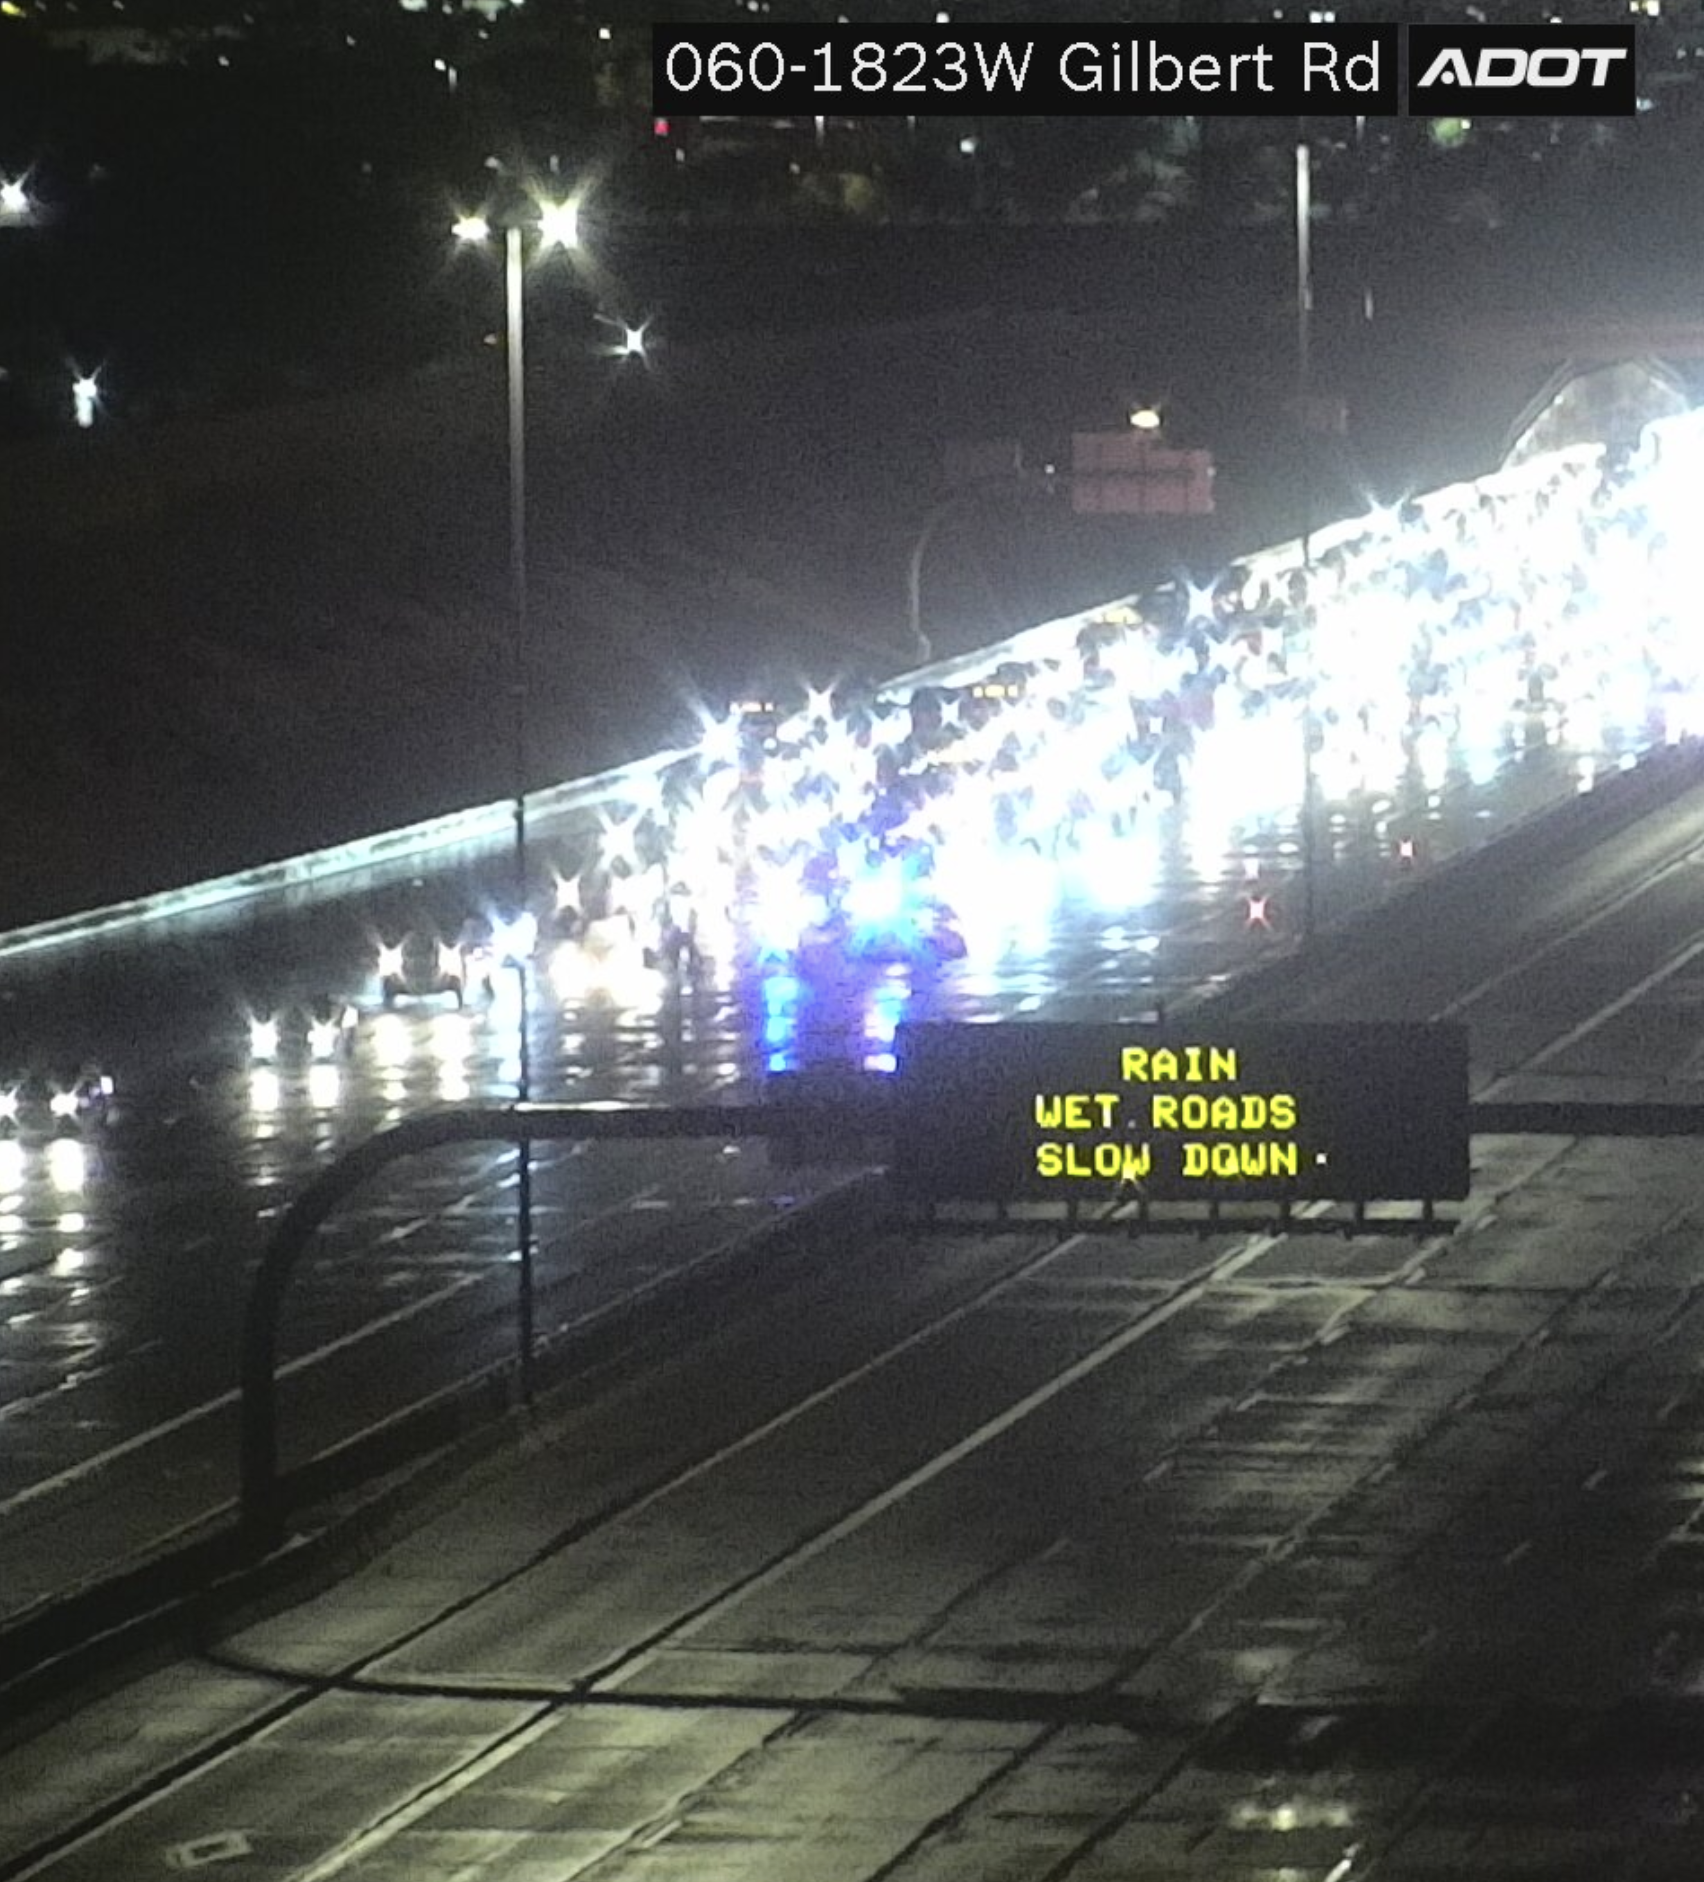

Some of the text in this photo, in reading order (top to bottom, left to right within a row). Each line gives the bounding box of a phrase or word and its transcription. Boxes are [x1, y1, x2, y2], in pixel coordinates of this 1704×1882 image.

[1121, 1046, 1237, 1082] RAIN
[1035, 1093, 1297, 1131] WET ROADS
[1036, 1141, 1297, 1178] SLOW DOWN
